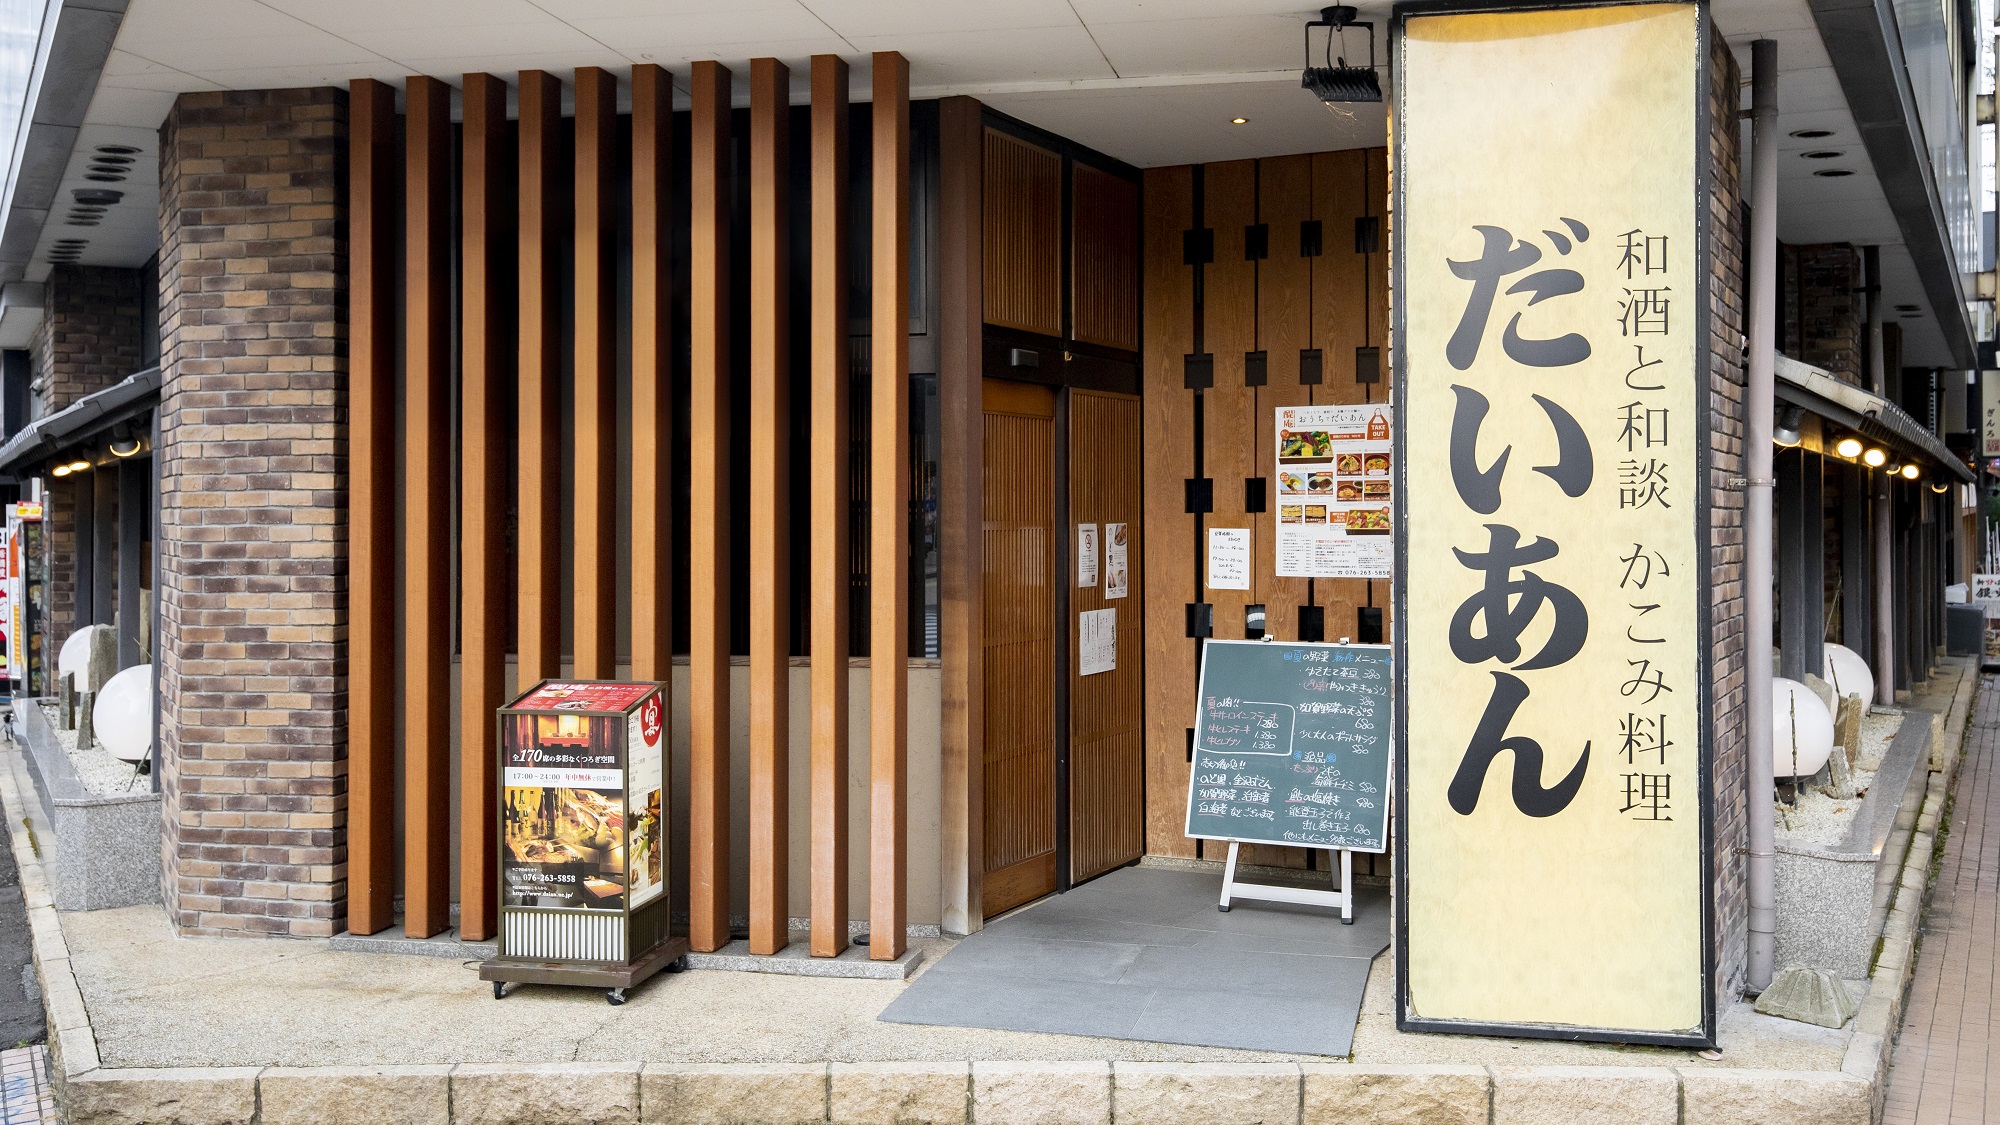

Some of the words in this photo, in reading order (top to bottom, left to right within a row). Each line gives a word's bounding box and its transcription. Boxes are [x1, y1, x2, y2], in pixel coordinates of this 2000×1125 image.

[1299, 414, 1366, 423] おうちでだいあん
[1615, 228, 1672, 511] 和酒と和談
[1445, 217, 1593, 818] だいあん
[1618, 541, 1673, 823] かこみ料理
[512, 749, 615, 764] 全170席の多彩なくつろぎ空間
[523, 873, 576, 883] 076-263-5858
